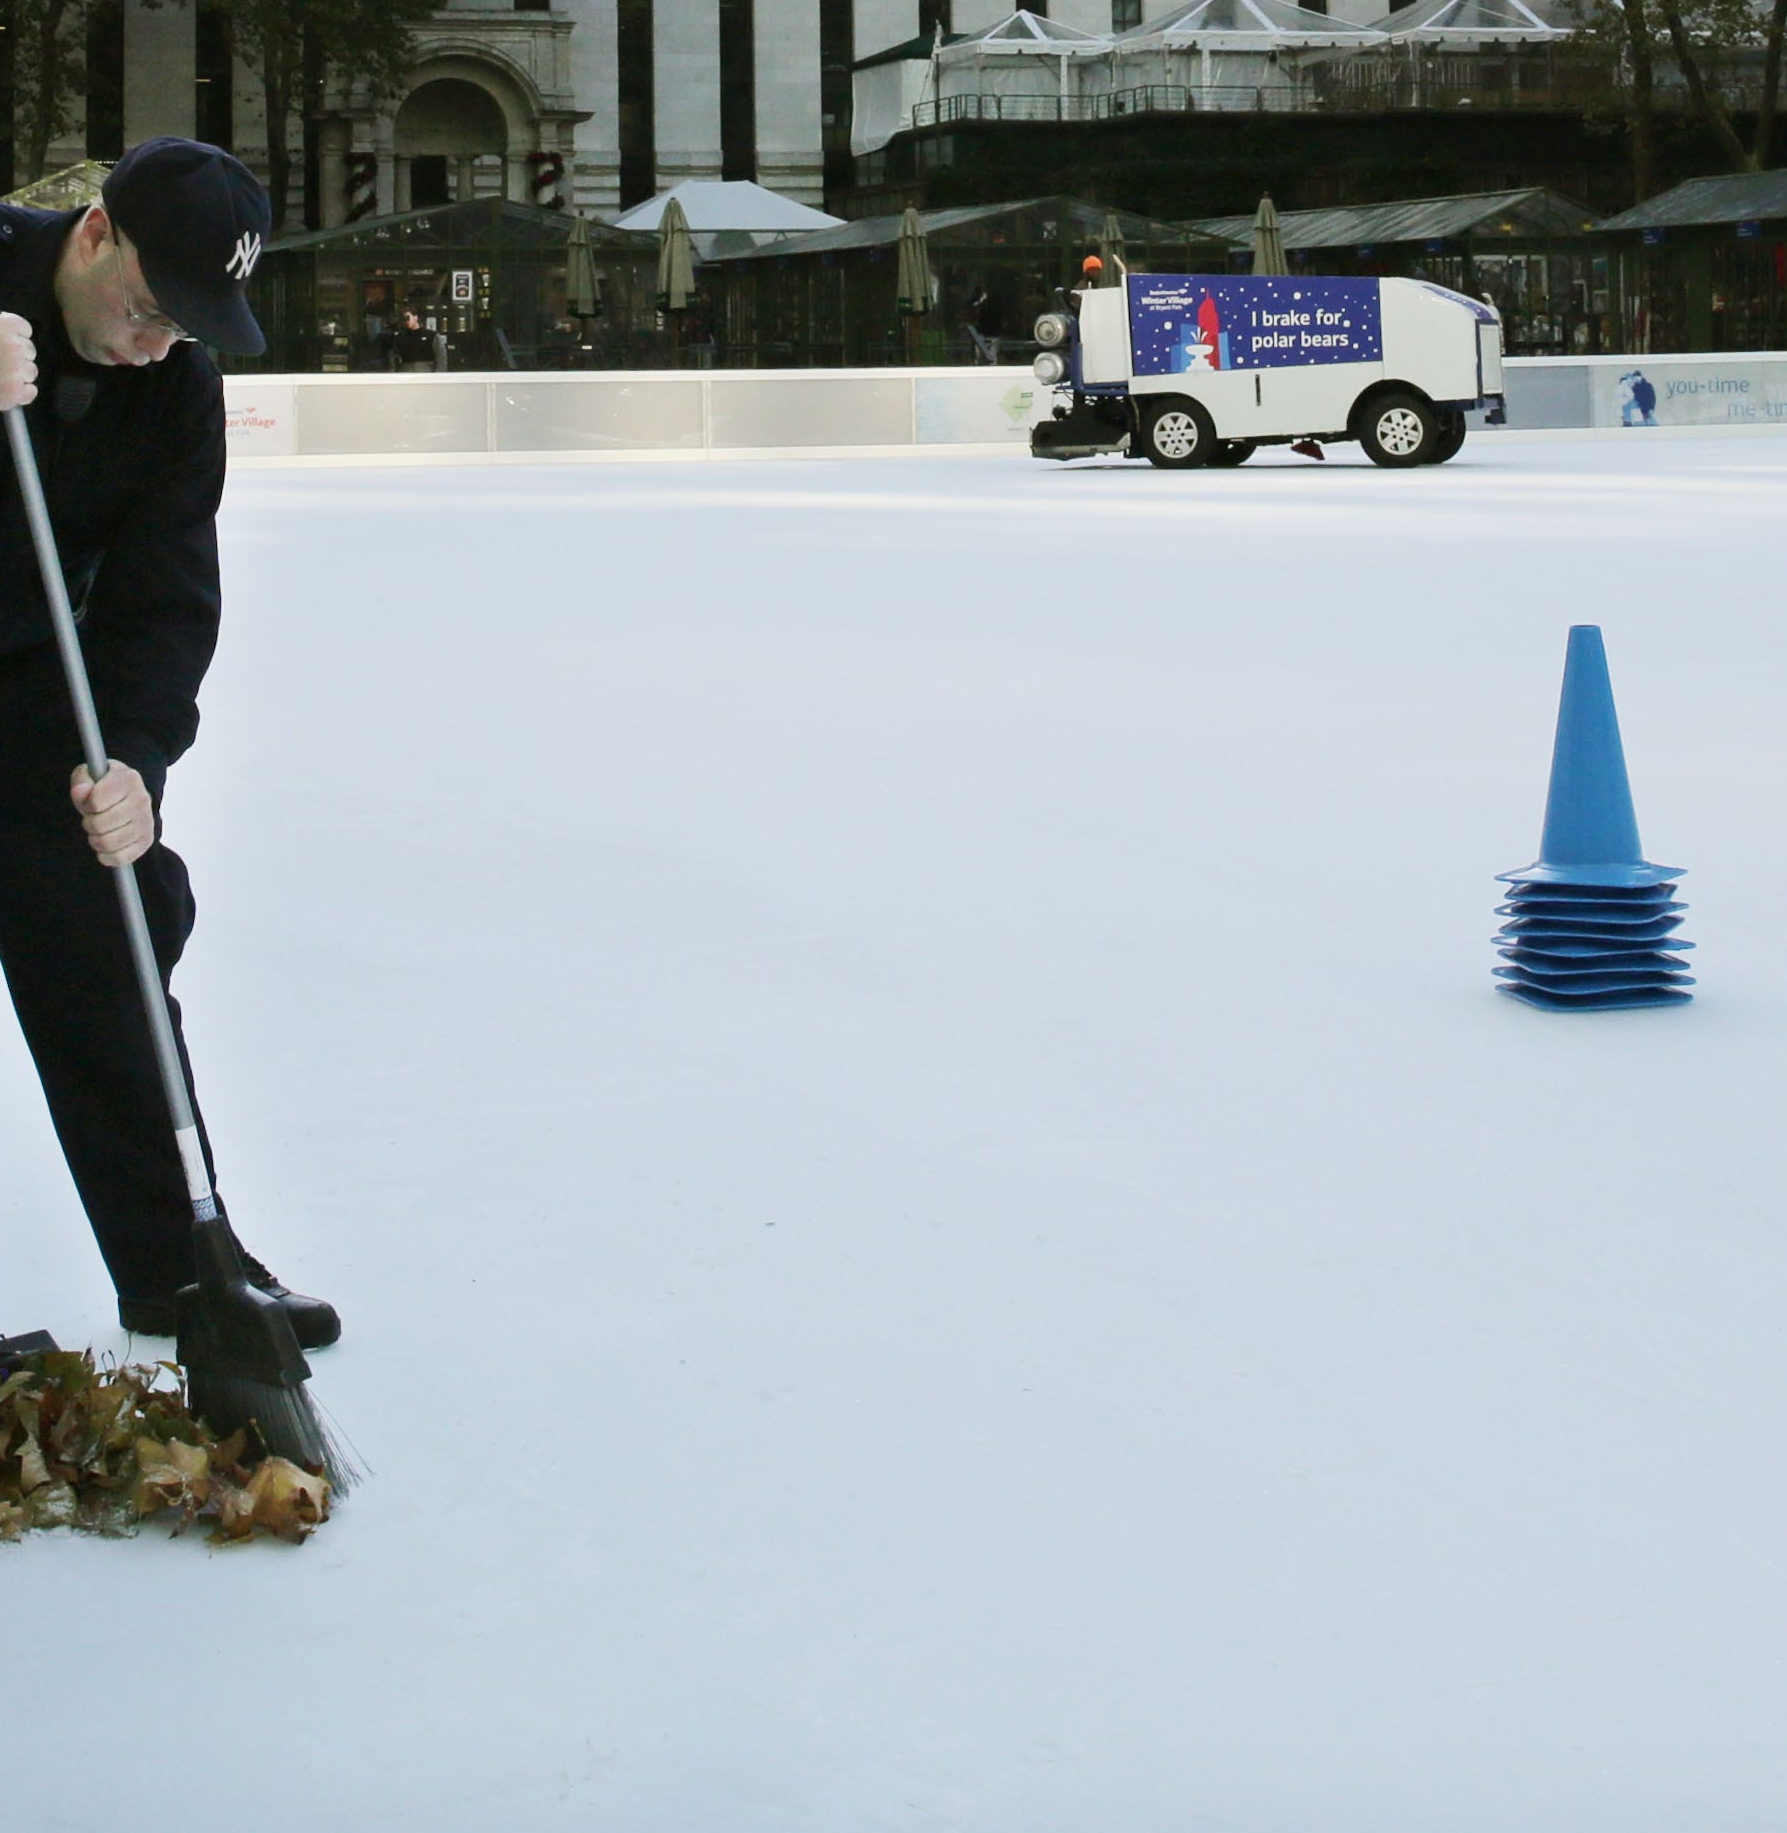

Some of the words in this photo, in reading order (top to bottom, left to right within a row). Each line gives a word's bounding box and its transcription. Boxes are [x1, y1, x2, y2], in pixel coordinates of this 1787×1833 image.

[1251, 310, 1257, 327] I
[1261, 309, 1311, 327] brake
[1315, 308, 1343, 326] for
[1251, 331, 1296, 353] polar
[1300, 330, 1350, 347] bears
[1666, 377, 1750, 400] you-time
[225, 418, 240, 427] ter
[242, 417, 275, 428] Village
